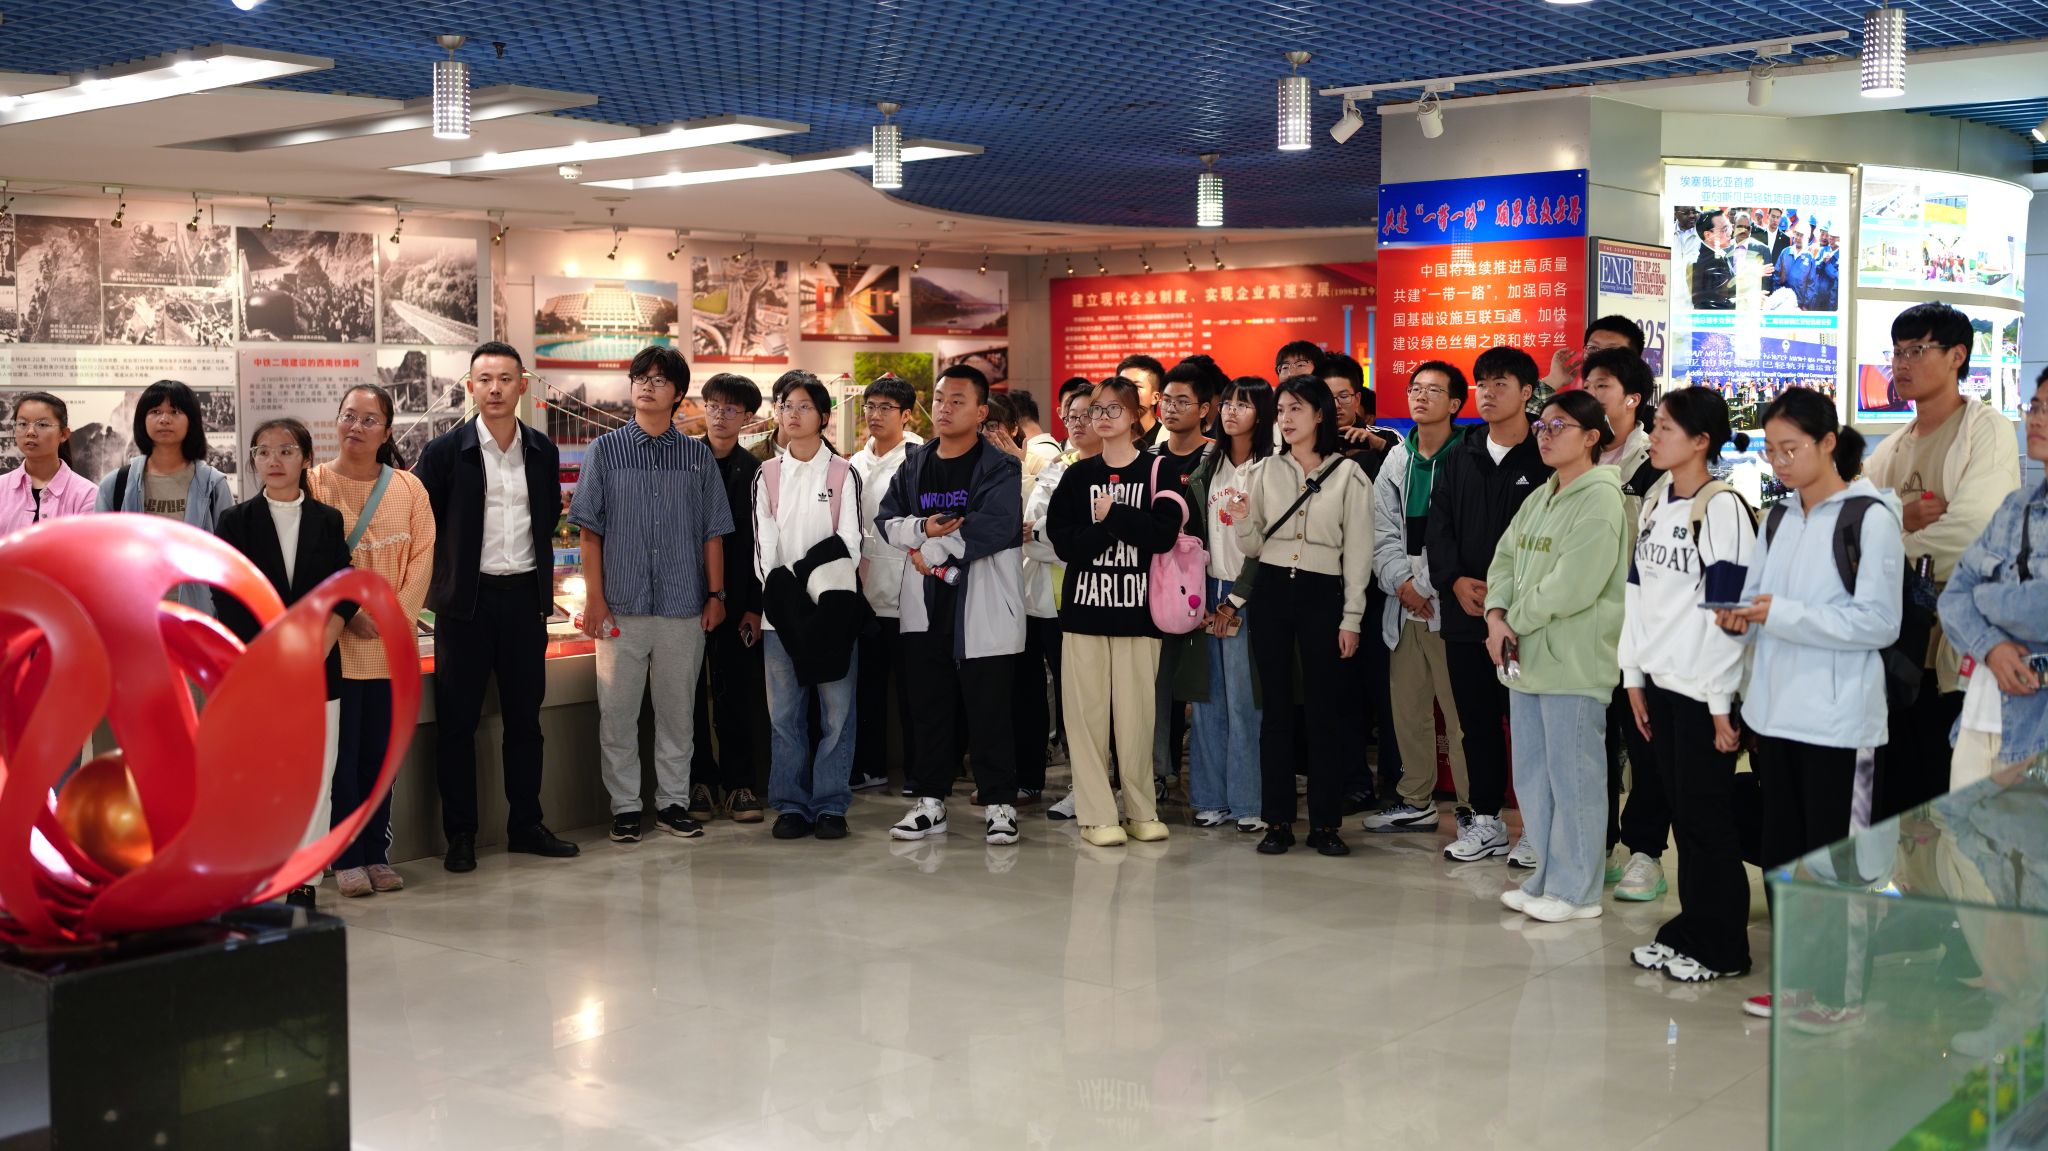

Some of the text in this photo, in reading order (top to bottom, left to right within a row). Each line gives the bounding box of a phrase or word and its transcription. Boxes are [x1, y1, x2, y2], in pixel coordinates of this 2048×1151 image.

[1420, 256, 1568, 279] 中国将继续推进高质量
[1600, 255, 1632, 286] ENR
[1634, 260, 1661, 273] THE TOP 225
[1634, 271, 1667, 286] INTERNATIONAL
[1634, 282, 1664, 296] CONTRACTORS
[1393, 306, 1567, 328] 国基础设施互联互通，加快
[1393, 359, 1430, 375] 绸之
